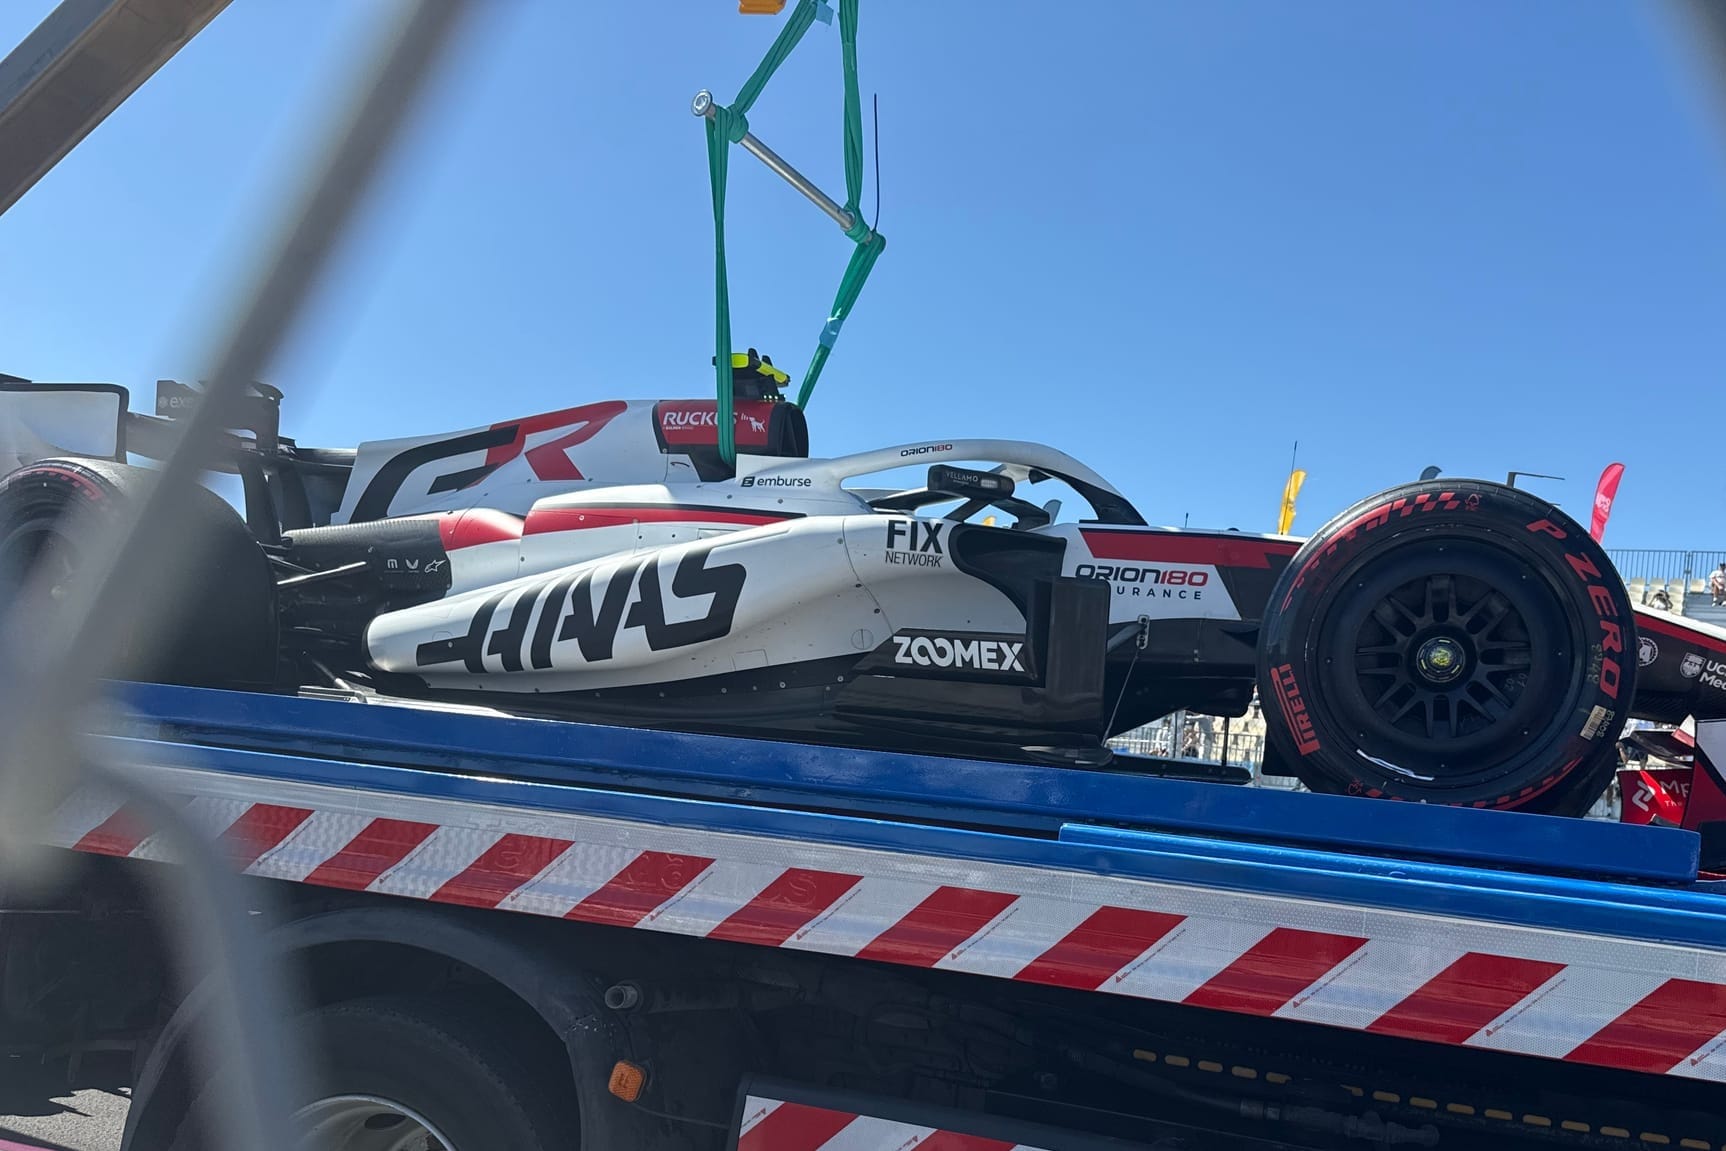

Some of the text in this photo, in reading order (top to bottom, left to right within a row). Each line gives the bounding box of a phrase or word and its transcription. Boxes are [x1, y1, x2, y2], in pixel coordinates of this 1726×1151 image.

[663, 412, 738, 426] RUCK
[756, 475, 812, 487] emburse
[886, 519, 944, 554] FIX
[885, 551, 943, 568] NETWORK
[1074, 564, 1209, 587] ORION180
[1116, 585, 1202, 600] URANCE
[416, 547, 747, 674] HAAS
[1526, 519, 1622, 700] P ZERO
[892, 635, 1025, 672] ZOOMEX
[1706, 660, 1726, 676] UC
[1270, 663, 1320, 756] PIRELLI
